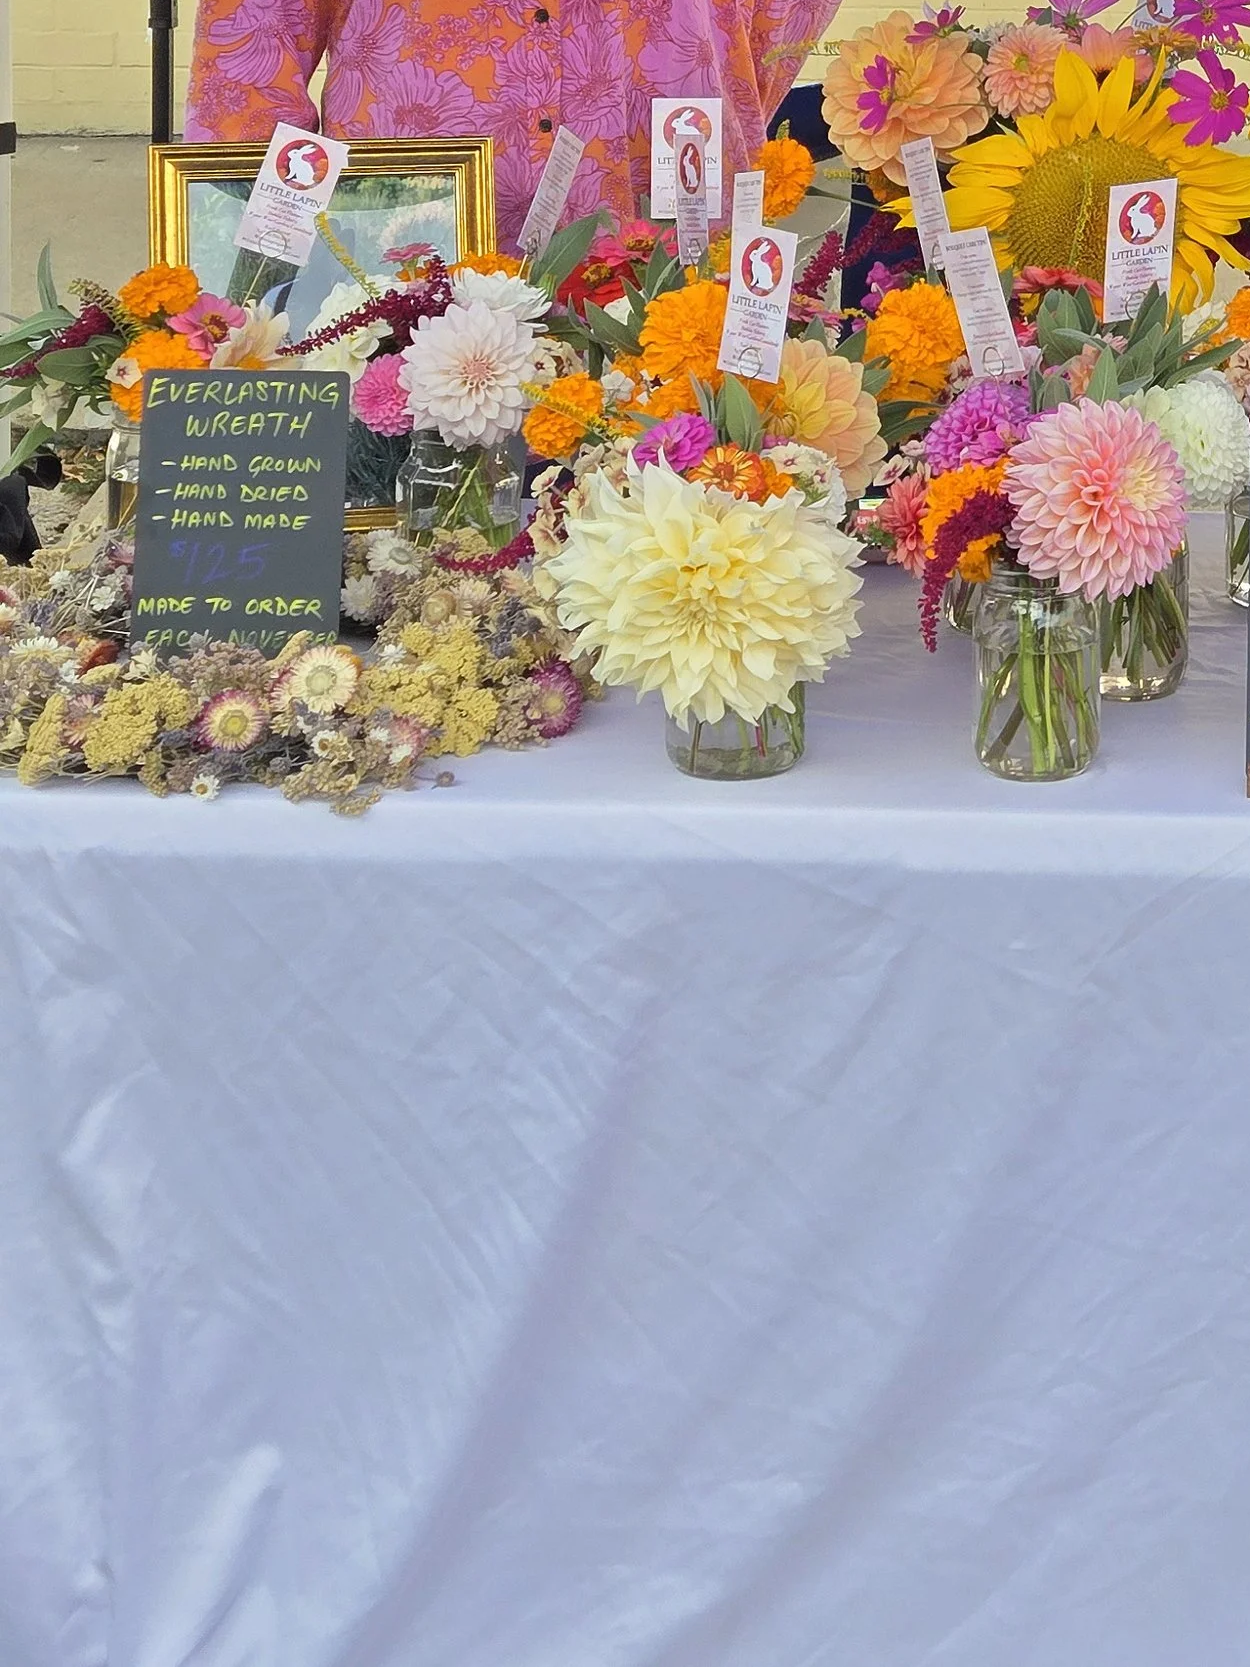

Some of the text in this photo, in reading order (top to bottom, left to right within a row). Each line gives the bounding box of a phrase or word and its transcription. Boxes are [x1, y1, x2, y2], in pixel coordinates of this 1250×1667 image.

[260, 182, 323, 209] LITTLE LAPIN
[1112, 249, 1140, 260] LITTLE
[732, 294, 757, 308] LITTLE
[147, 377, 340, 410] EVERLASTING
[186, 411, 313, 439] WREATH
[248, 455, 322, 478] GROWN
[240, 484, 309, 502] DRIED
[244, 515, 312, 530] MADE
[137, 596, 323, 621] MADE TO ORDER
